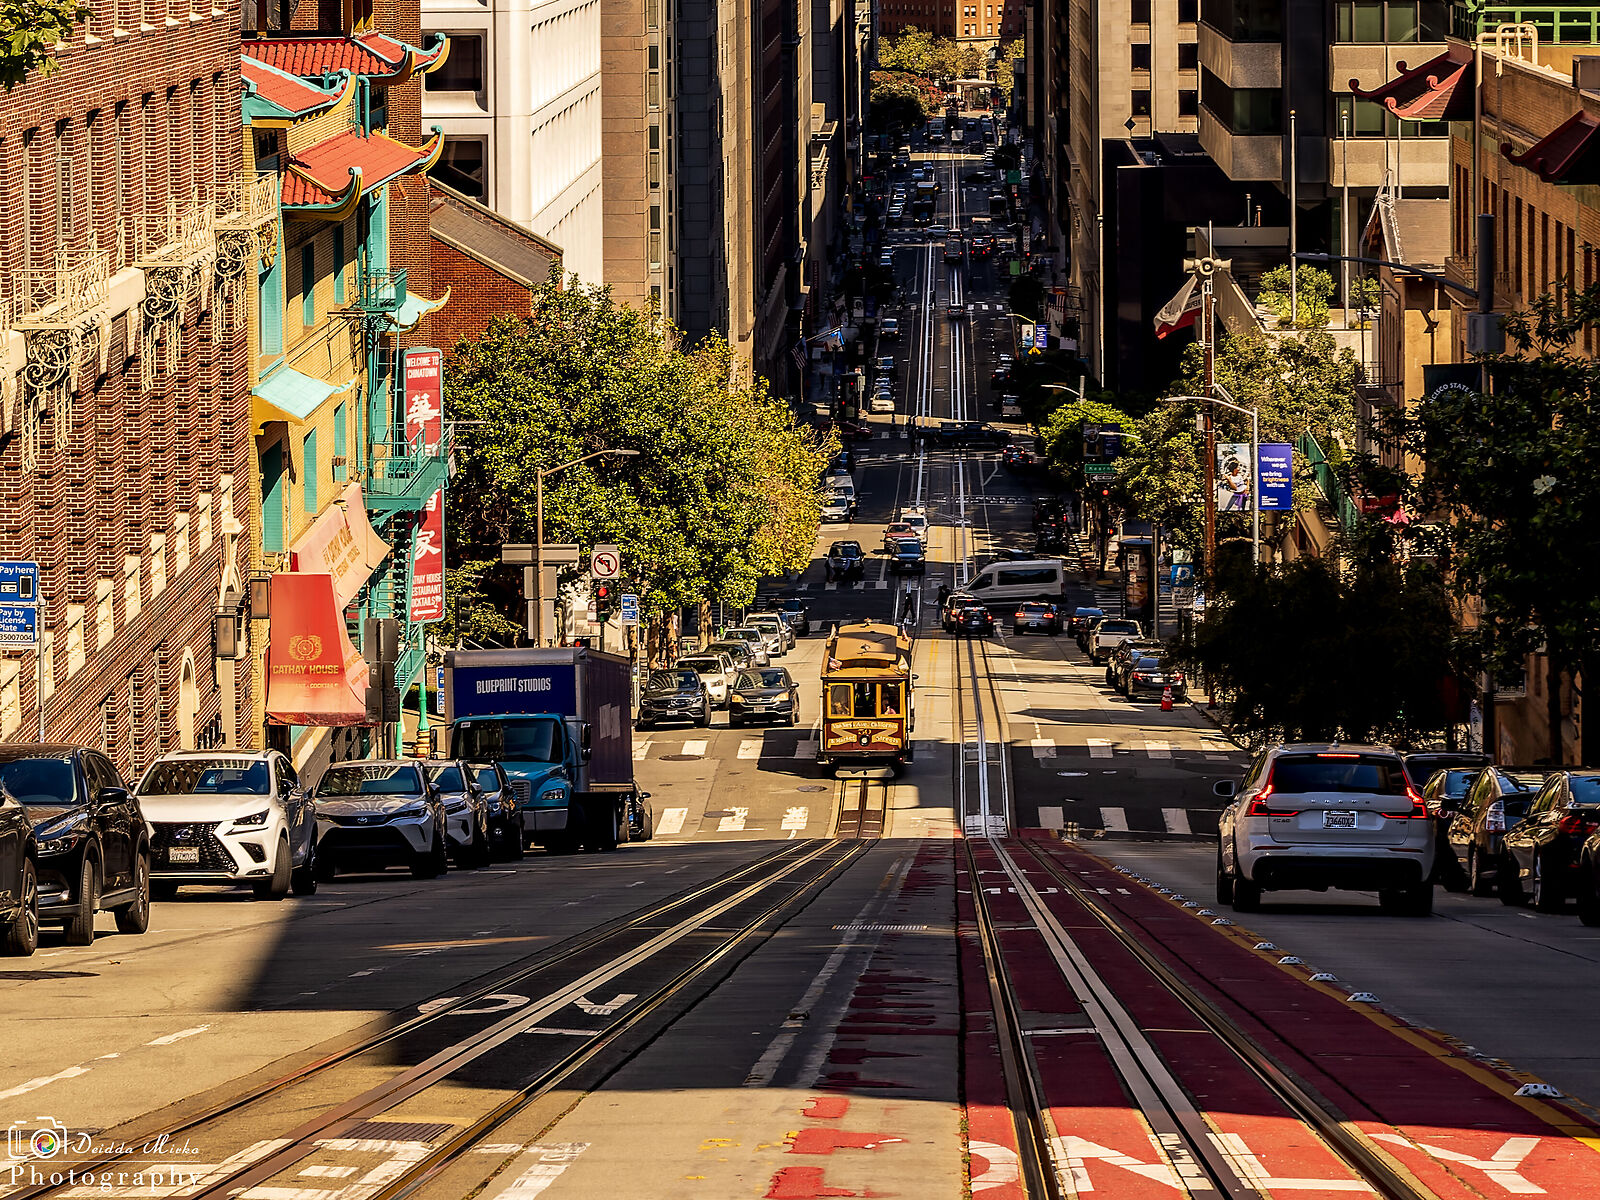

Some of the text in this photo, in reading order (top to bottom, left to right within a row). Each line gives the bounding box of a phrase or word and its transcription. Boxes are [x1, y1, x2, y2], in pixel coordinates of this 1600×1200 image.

[406, 356, 439, 367] WELCOME TO
[408, 368, 437, 379] CHINATOWN
[1450, 383, 1469, 392] STATE
[0, 566, 34, 575] Pay here
[427, 573, 441, 583] HOUSE
[412, 584, 441, 597] ESTAURANT
[411, 596, 436, 608] OCKTAILS
[14, 609, 24, 618] by
[273, 664, 339, 675] CATHAY HOUSE
[477, 677, 551, 694] BLUEPRINT STUDIOS
